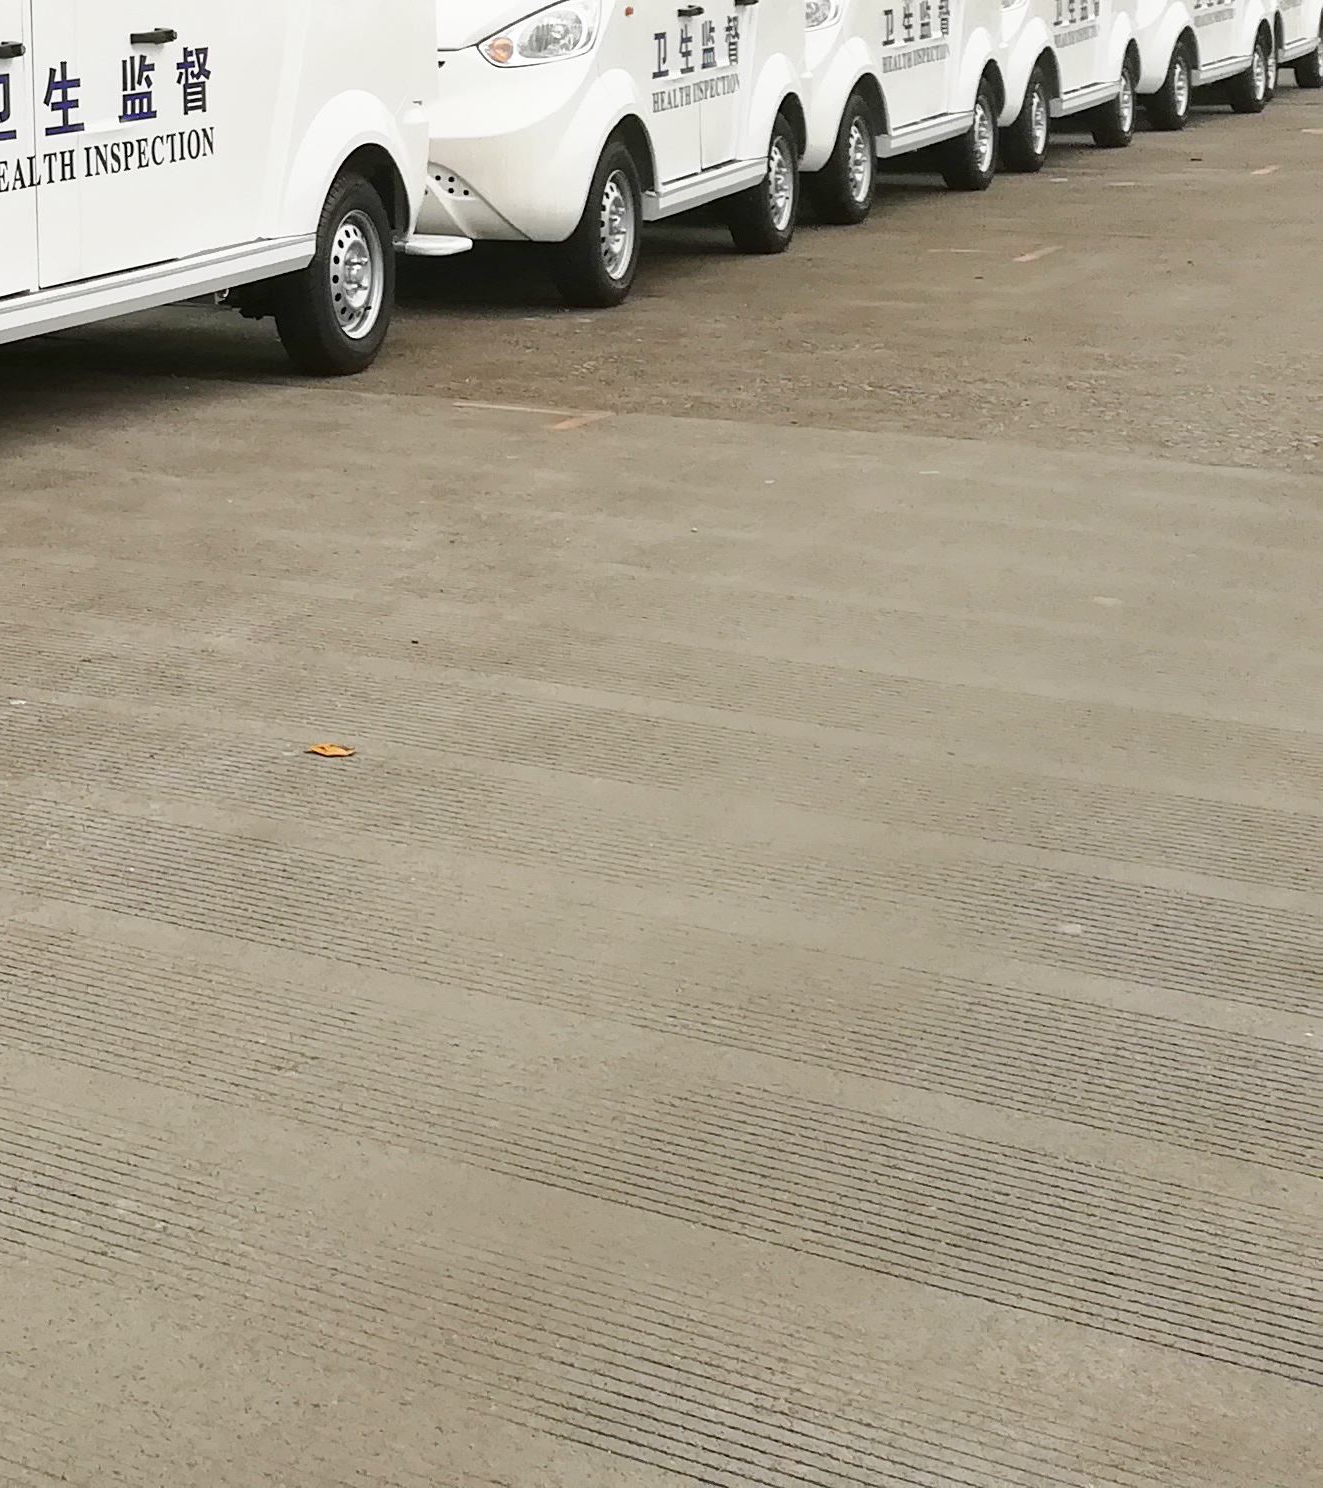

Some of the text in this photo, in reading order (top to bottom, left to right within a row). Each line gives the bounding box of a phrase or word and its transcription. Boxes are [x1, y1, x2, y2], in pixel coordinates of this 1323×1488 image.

[652, 15, 740, 79] 卫生监督
[652, 85, 691, 113] HEALTH
[84, 126, 216, 177] INSPECTION
